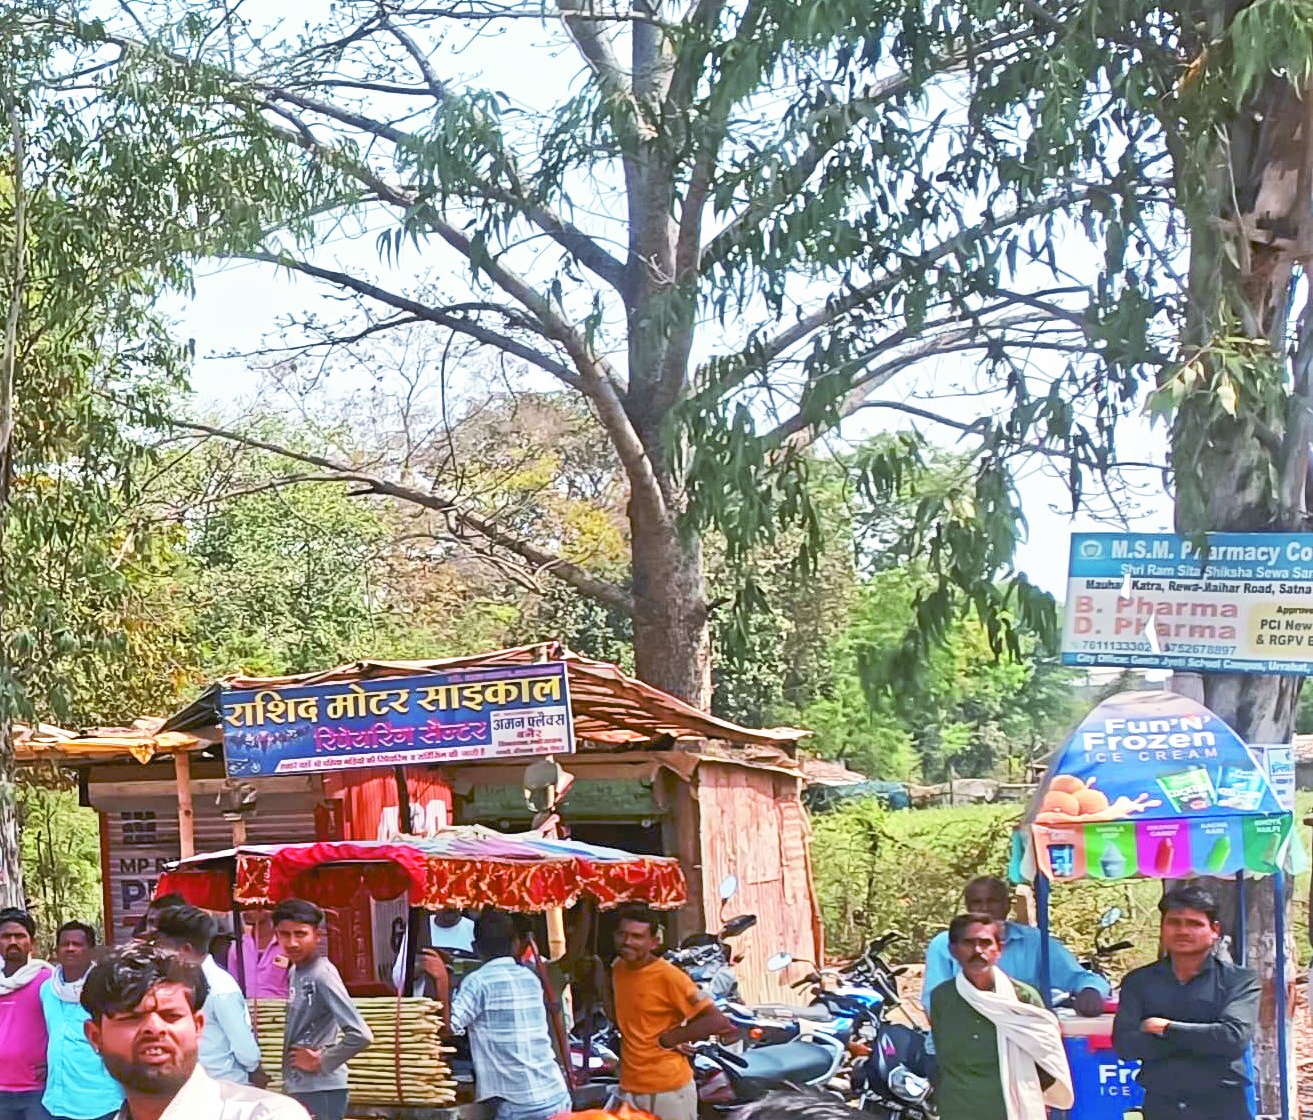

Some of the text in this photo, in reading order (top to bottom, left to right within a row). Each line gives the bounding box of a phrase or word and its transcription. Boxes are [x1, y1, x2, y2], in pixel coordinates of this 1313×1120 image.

[1111, 540, 1175, 559] M.S.M.
[1147, 564, 1174, 576] Ram
[1256, 566, 1289, 578] Sewa
[1132, 580, 1165, 594] Katra,
[1243, 583, 1275, 596] Road,
[1279, 583, 1312, 595] Satna
[1076, 595, 1238, 618] B. Pharma
[1073, 615, 1102, 634] D.
[1260, 619, 1313, 632] PCI New
[1256, 634, 1264, 645] &
[1269, 634, 1304, 646] RGPV
[223, 674, 563, 727] राशिद मोटर साइकाल
[1082, 731, 1216, 751] Frozen
[1084, 749, 1218, 763] ICE CREAM
[1100, 1085, 1131, 1096] ICE
